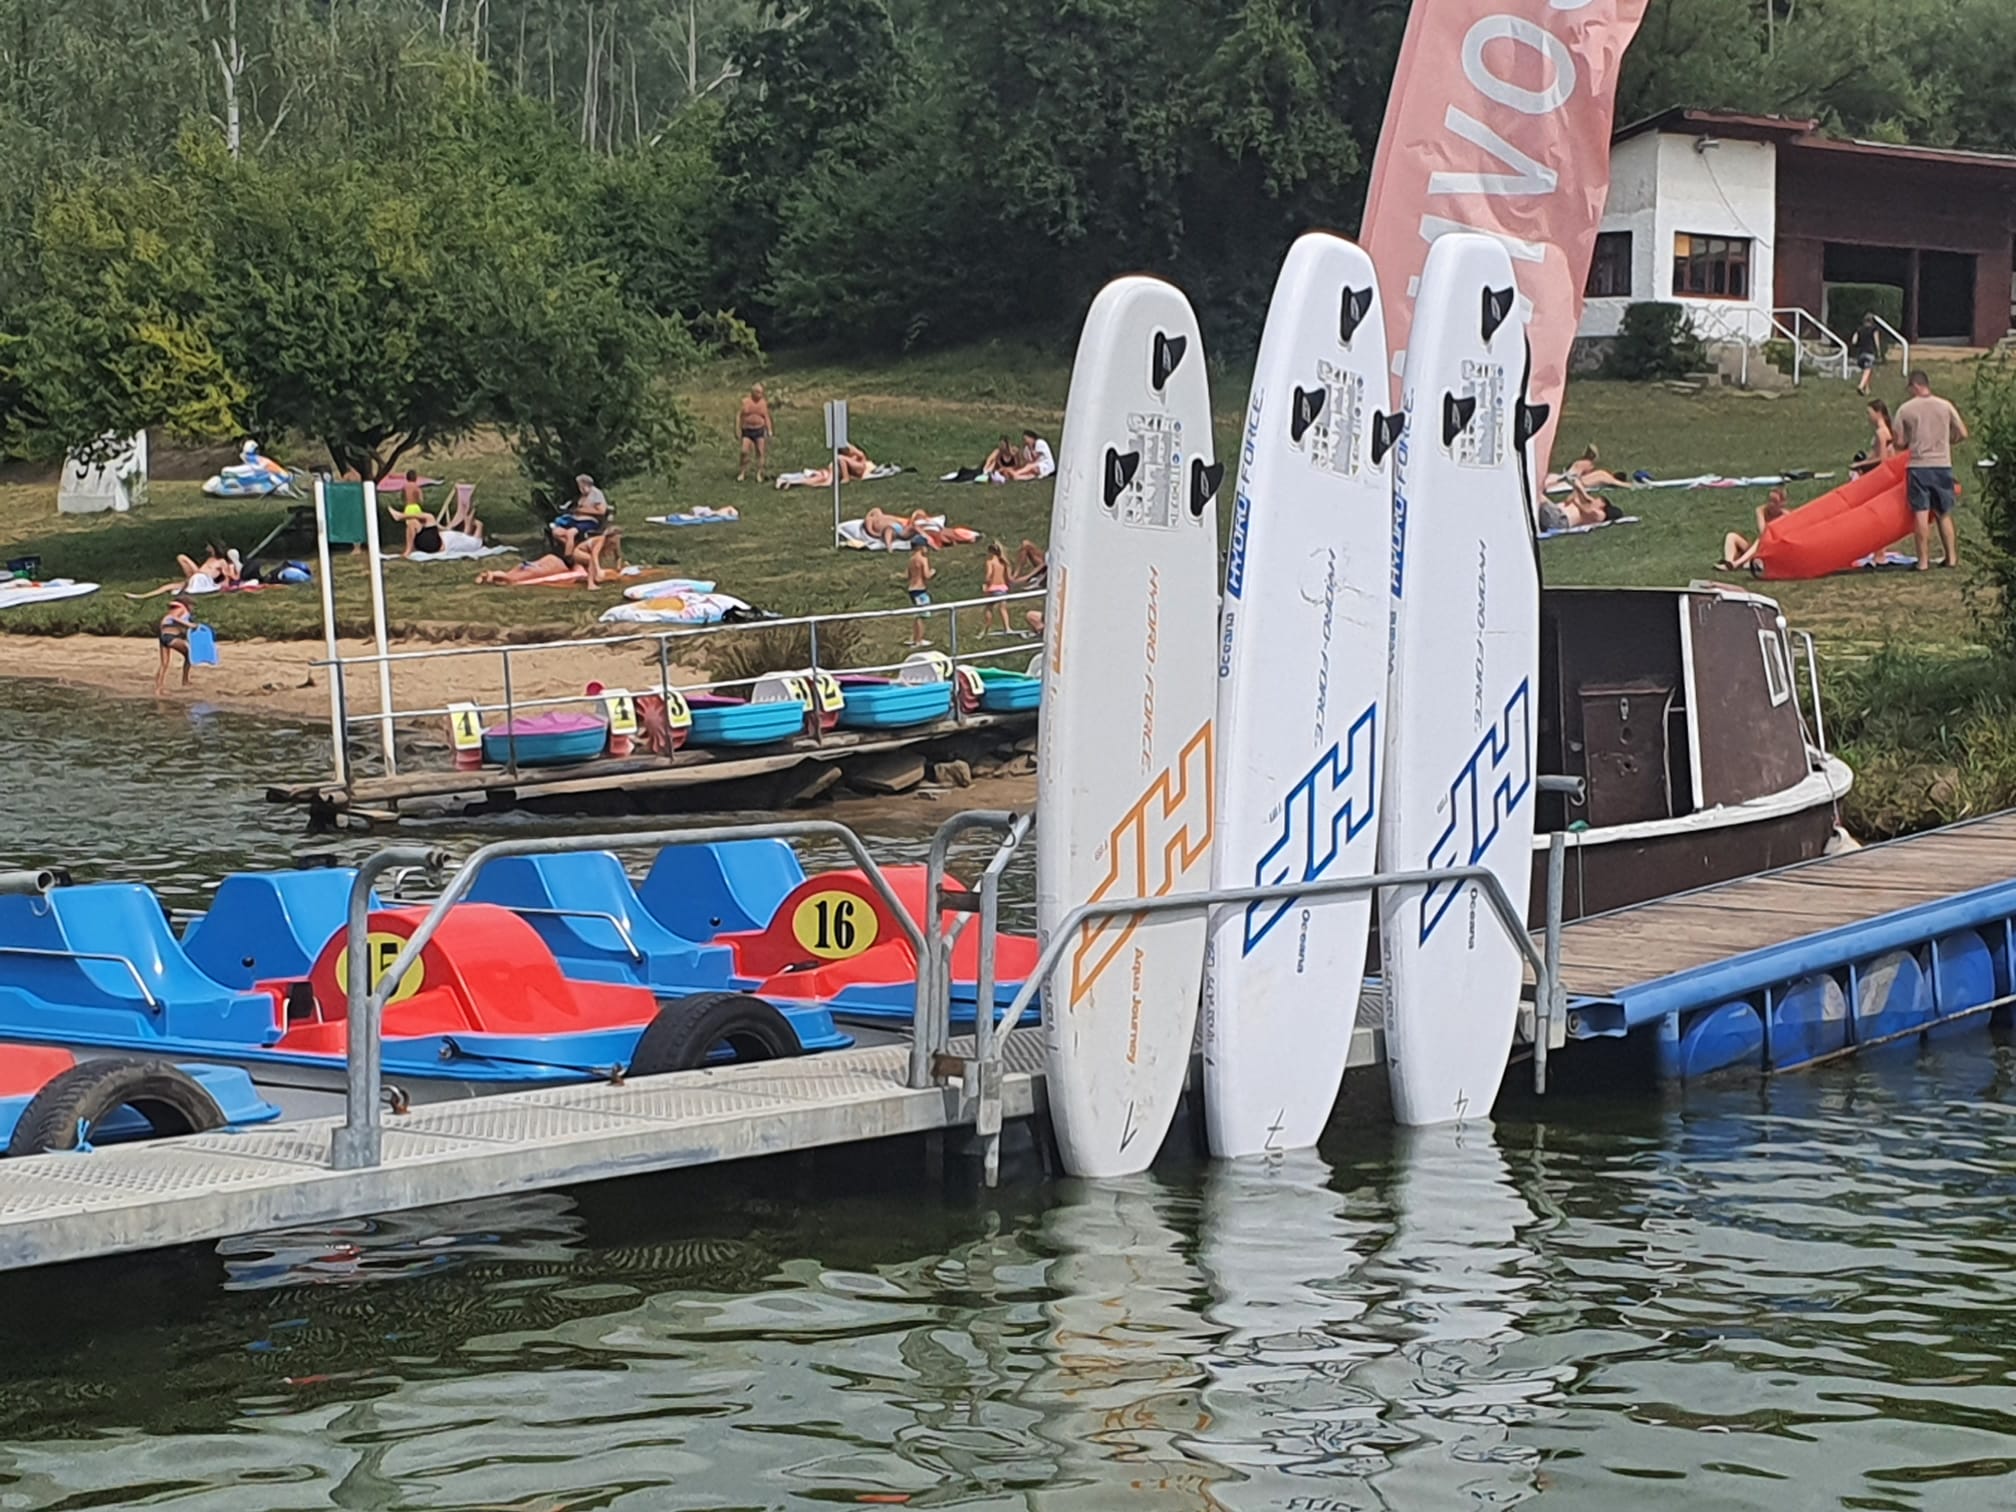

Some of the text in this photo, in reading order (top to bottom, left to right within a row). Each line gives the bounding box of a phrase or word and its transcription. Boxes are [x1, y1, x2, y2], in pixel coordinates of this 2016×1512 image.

[1218, 612, 1236, 679] Oceana
[613, 696, 630, 721] 4
[815, 677, 837, 701] 2
[813, 899, 855, 951] 16
[1297, 908, 1310, 974] Oceana
[1467, 886, 1478, 951] Oceana
[1126, 946, 1145, 1065] Aqua Journey
